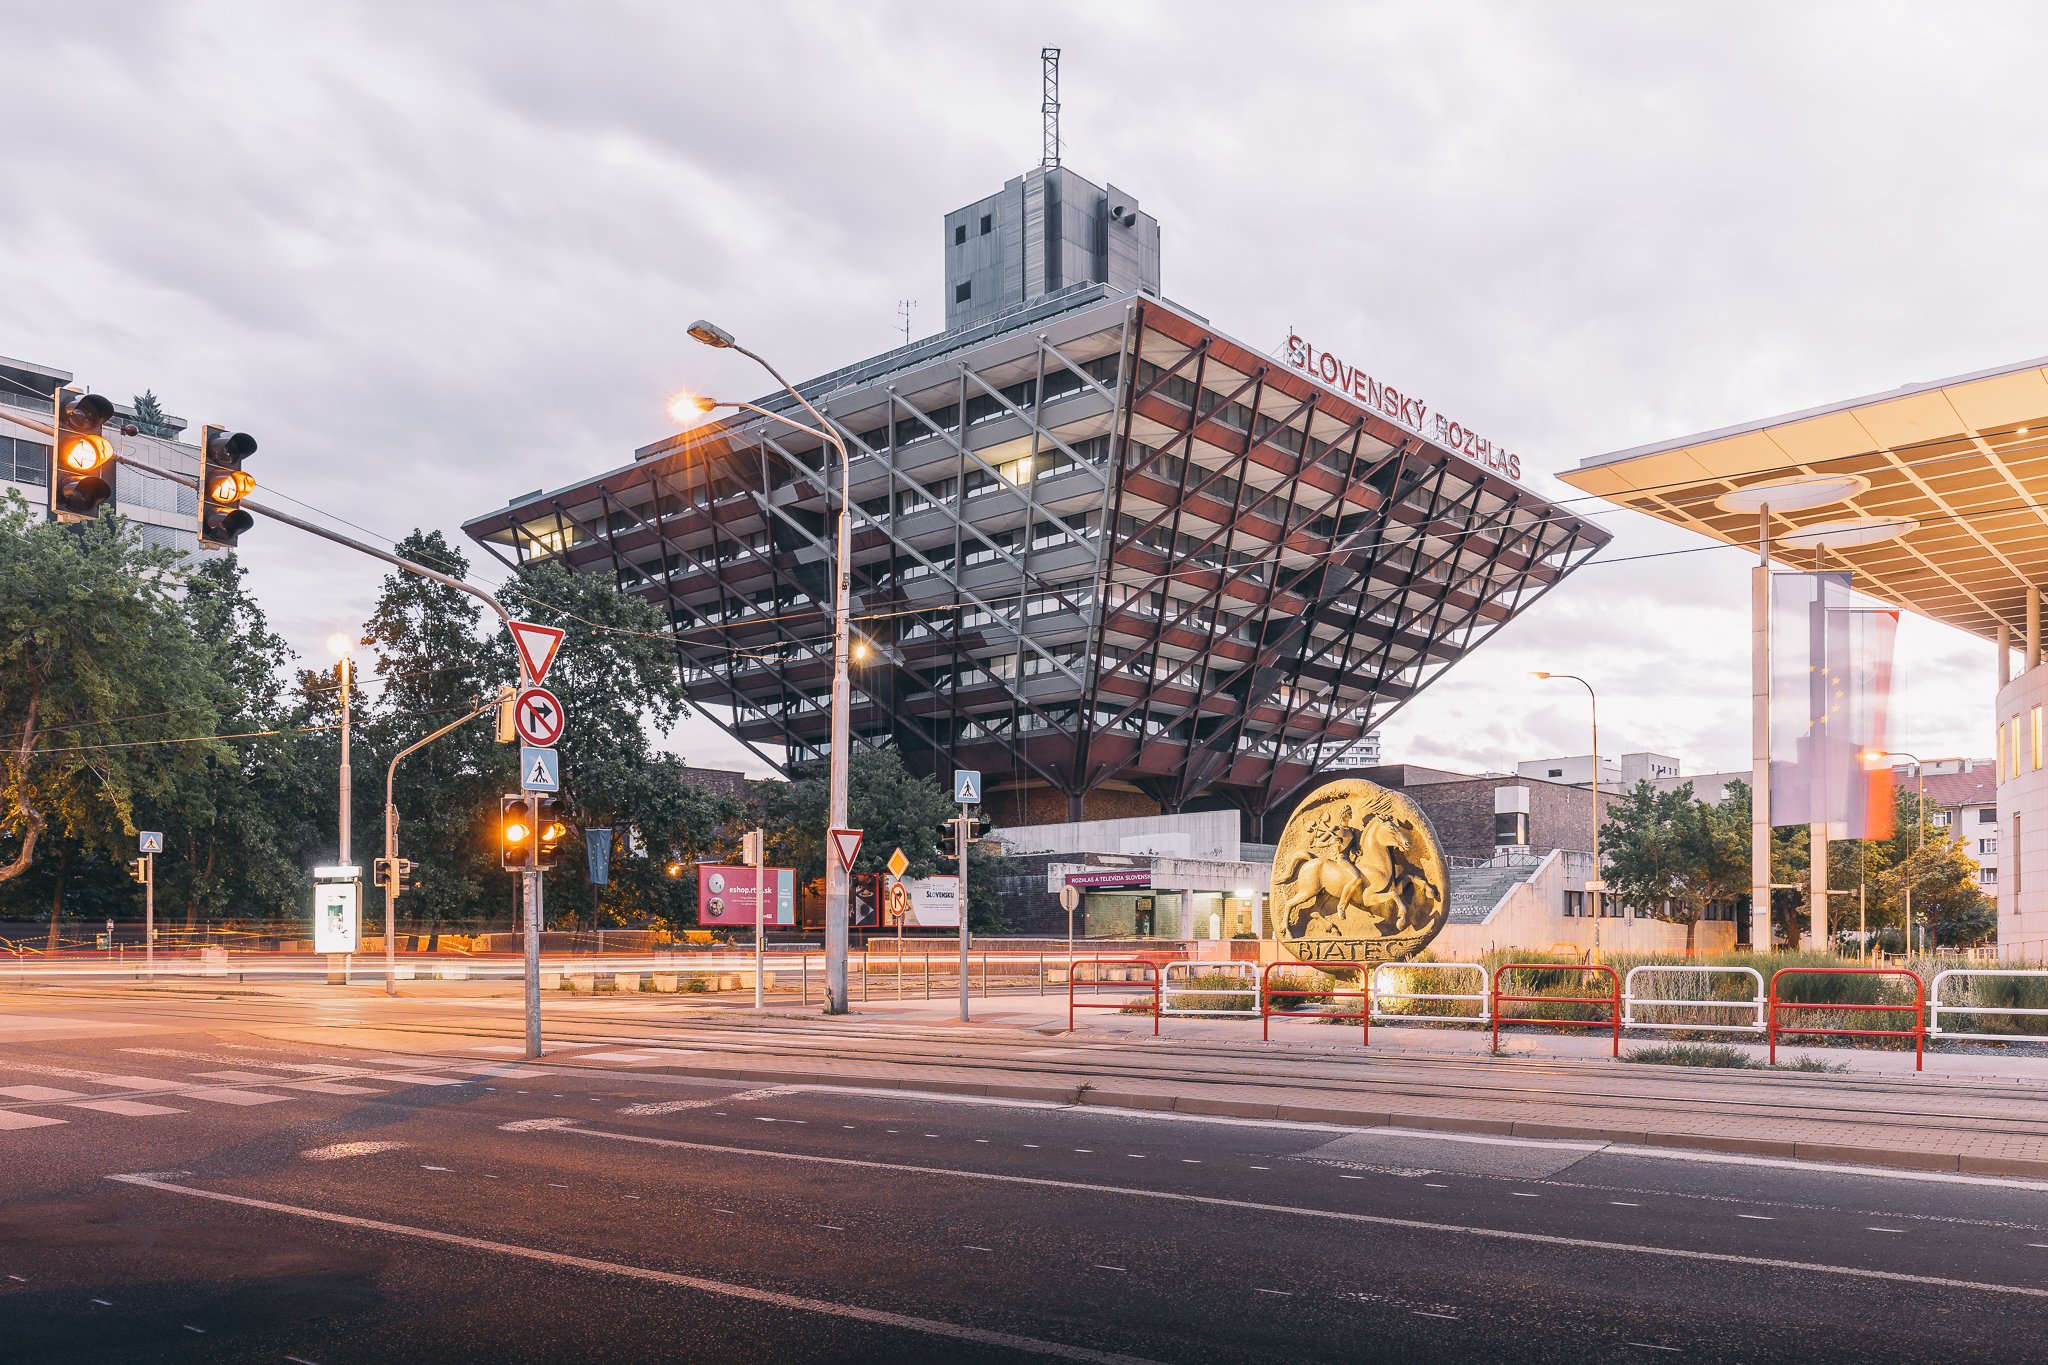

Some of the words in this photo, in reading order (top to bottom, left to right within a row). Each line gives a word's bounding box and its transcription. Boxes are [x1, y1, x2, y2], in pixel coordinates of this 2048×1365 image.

[1288, 335, 1427, 432] SLOVENSKÝ
[1435, 413, 1521, 480] ROZHLAS
[729, 886, 772, 894] eshop.rt.sk
[1299, 941, 1404, 961] BIATEC
